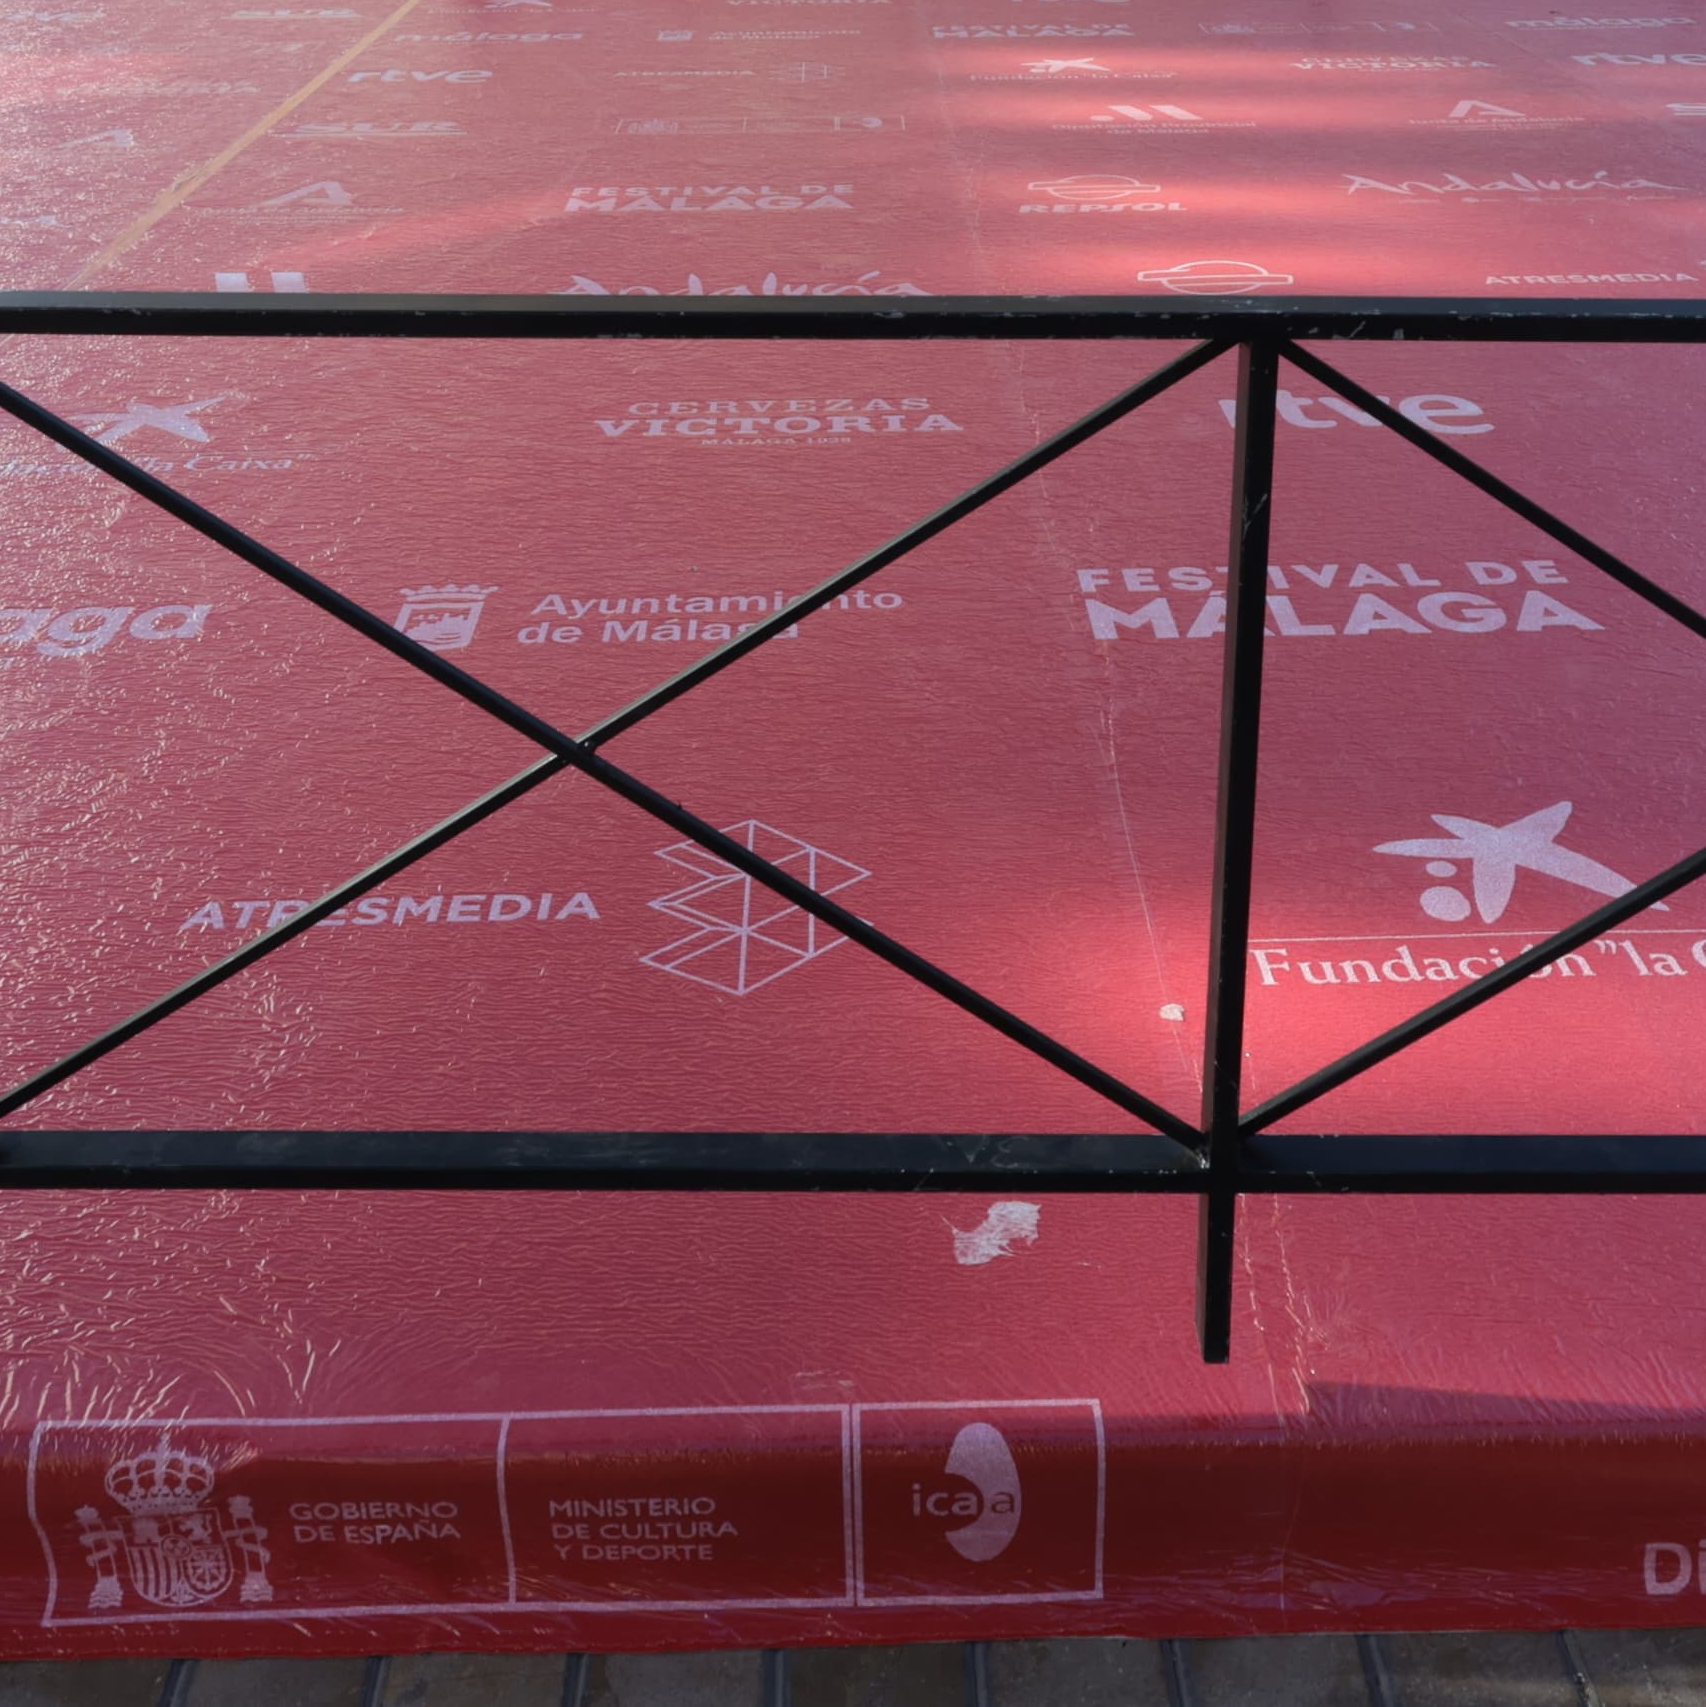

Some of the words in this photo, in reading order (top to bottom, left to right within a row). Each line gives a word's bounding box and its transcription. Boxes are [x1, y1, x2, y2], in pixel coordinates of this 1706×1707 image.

[346, 69, 492, 83] rtve
[1291, 61, 1494, 70] VICTORIA
[294, 121, 463, 133] SUR
[570, 185, 782, 197] FESTIVAL
[799, 184, 855, 194] DE
[1337, 170, 1691, 196] Andalucía
[1019, 202, 1188, 213] REPSOL
[1484, 273, 1700, 286] ATRESMEDIA
[628, 397, 931, 415] CERVEZAS
[595, 413, 965, 437] VICTORIA
[1466, 559, 1569, 586] DE
[531, 587, 904, 620] Ayuntaminto
[518, 619, 580, 645] de
[601, 618, 801, 645] Málaa
[290, 1499, 460, 1524] GOBIERNO
[548, 1495, 716, 1520] MINISTERIO
[294, 1522, 339, 1546] DE
[344, 1516, 461, 1546] ESPAÑA
[551, 1521, 598, 1543] DE
[603, 1518, 739, 1542] CULTURA
[552, 1542, 573, 1563] Y
[579, 1540, 714, 1563] DEPORTE
